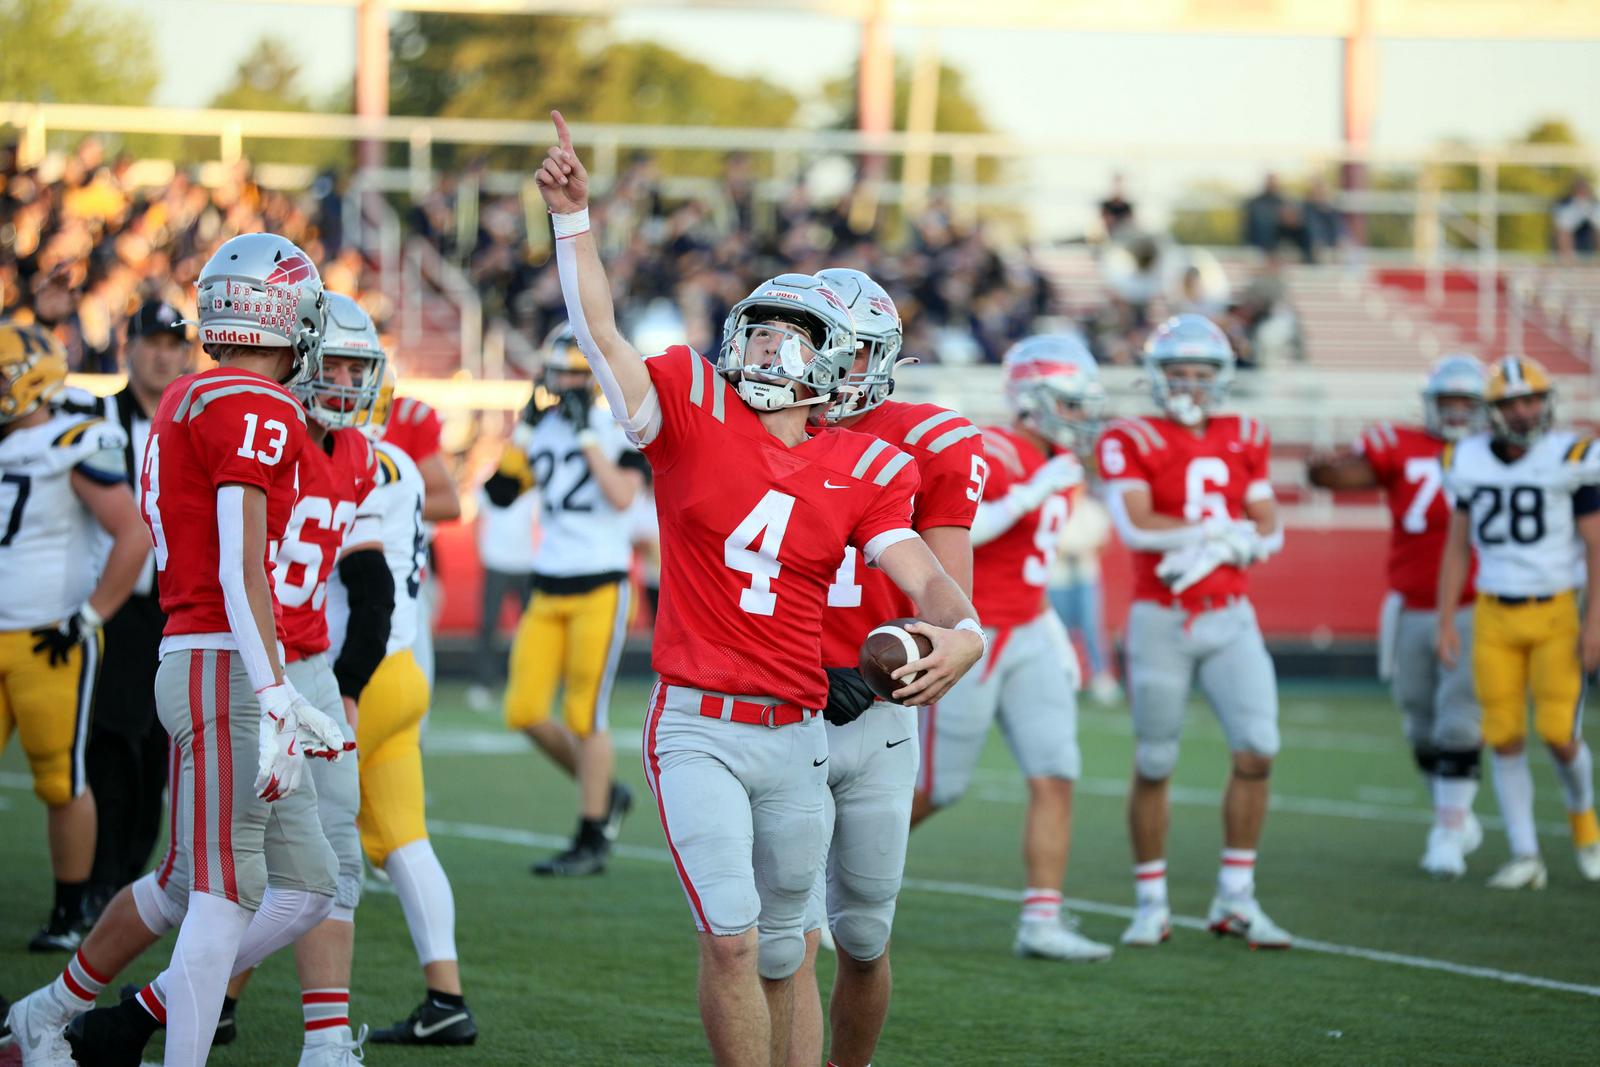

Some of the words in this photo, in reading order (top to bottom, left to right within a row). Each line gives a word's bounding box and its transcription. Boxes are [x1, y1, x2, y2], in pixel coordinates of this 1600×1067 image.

[214, 299, 222, 309] 13
[204, 329, 261, 344] Riddell
[236, 412, 288, 466] 13
[1101, 437, 1126, 475] 6
[0, 473, 31, 547] 7
[529, 449, 593, 511] 22
[1184, 457, 1230, 522] 6
[1022, 494, 1068, 586] 9
[1471, 485, 1546, 545] 28
[724, 488, 796, 616] 4
